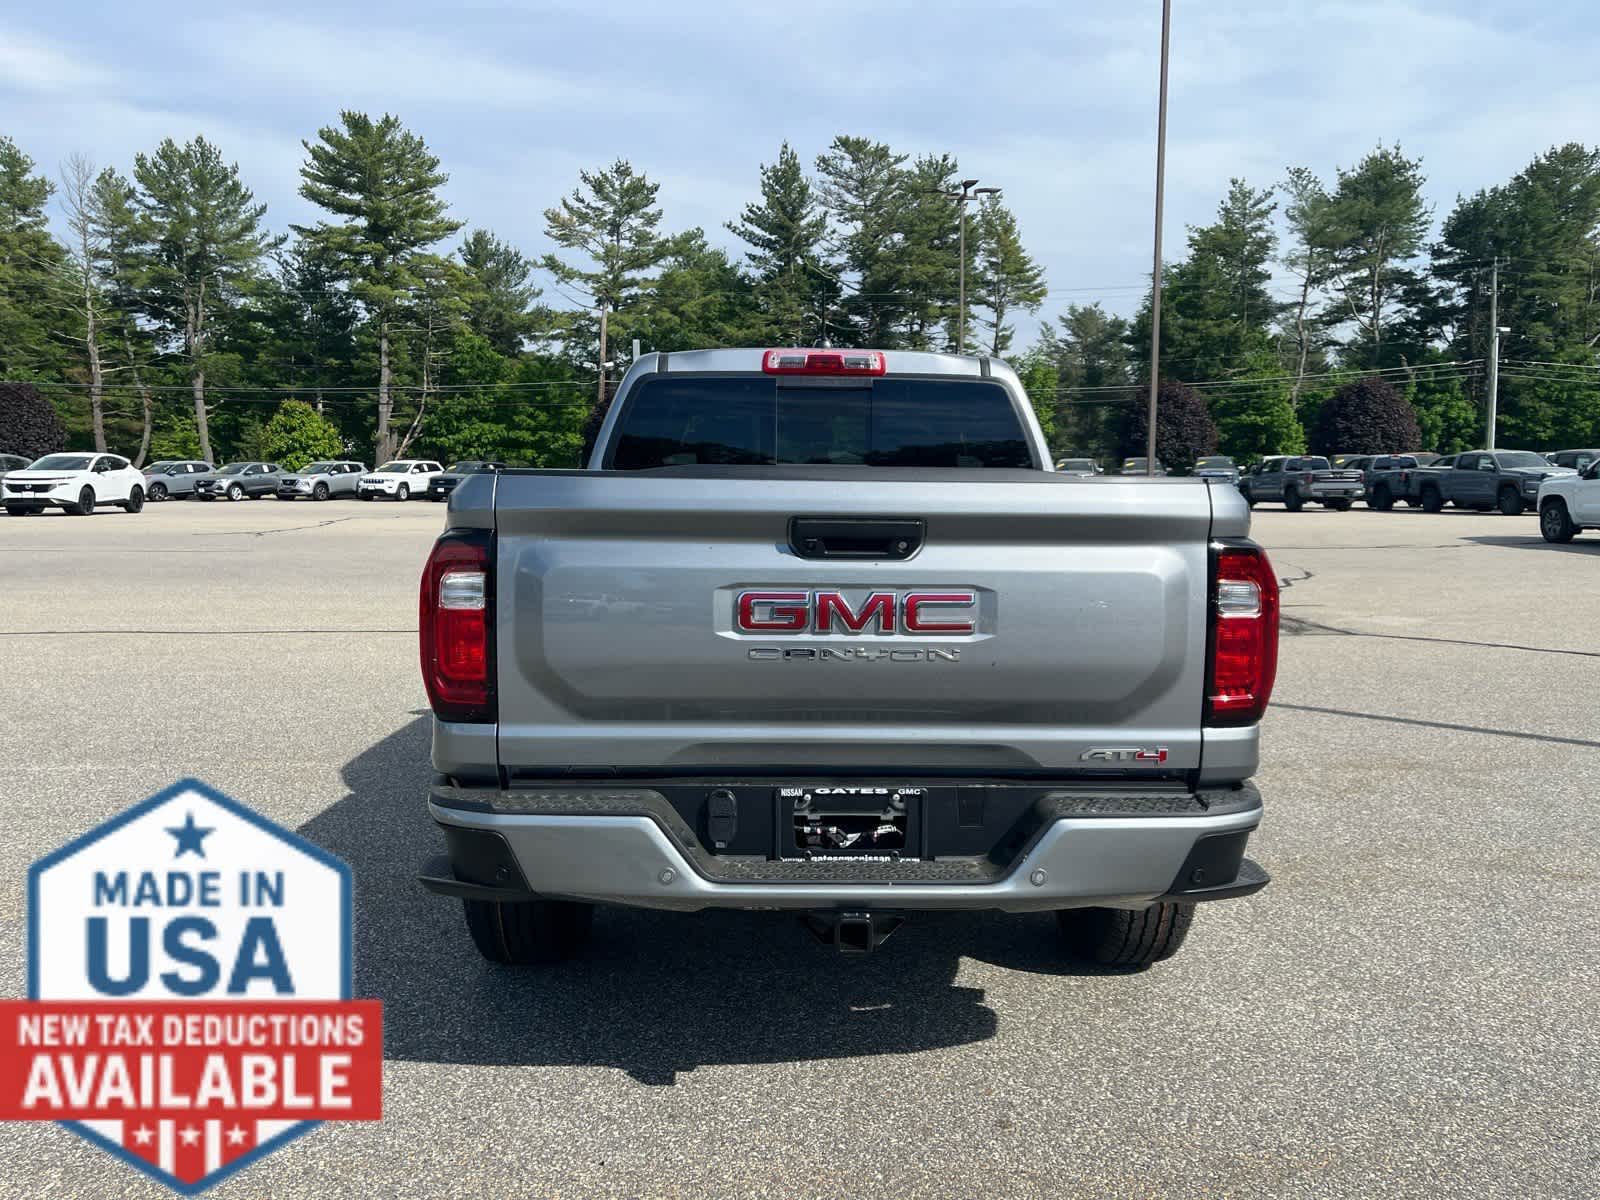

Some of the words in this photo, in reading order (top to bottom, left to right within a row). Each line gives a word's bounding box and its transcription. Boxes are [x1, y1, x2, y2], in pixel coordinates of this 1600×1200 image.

[737, 591, 976, 632] GMC
[748, 648, 960, 661] CANYON
[1080, 747, 1169, 763] AT4
[780, 788, 803, 797] NISSAN
